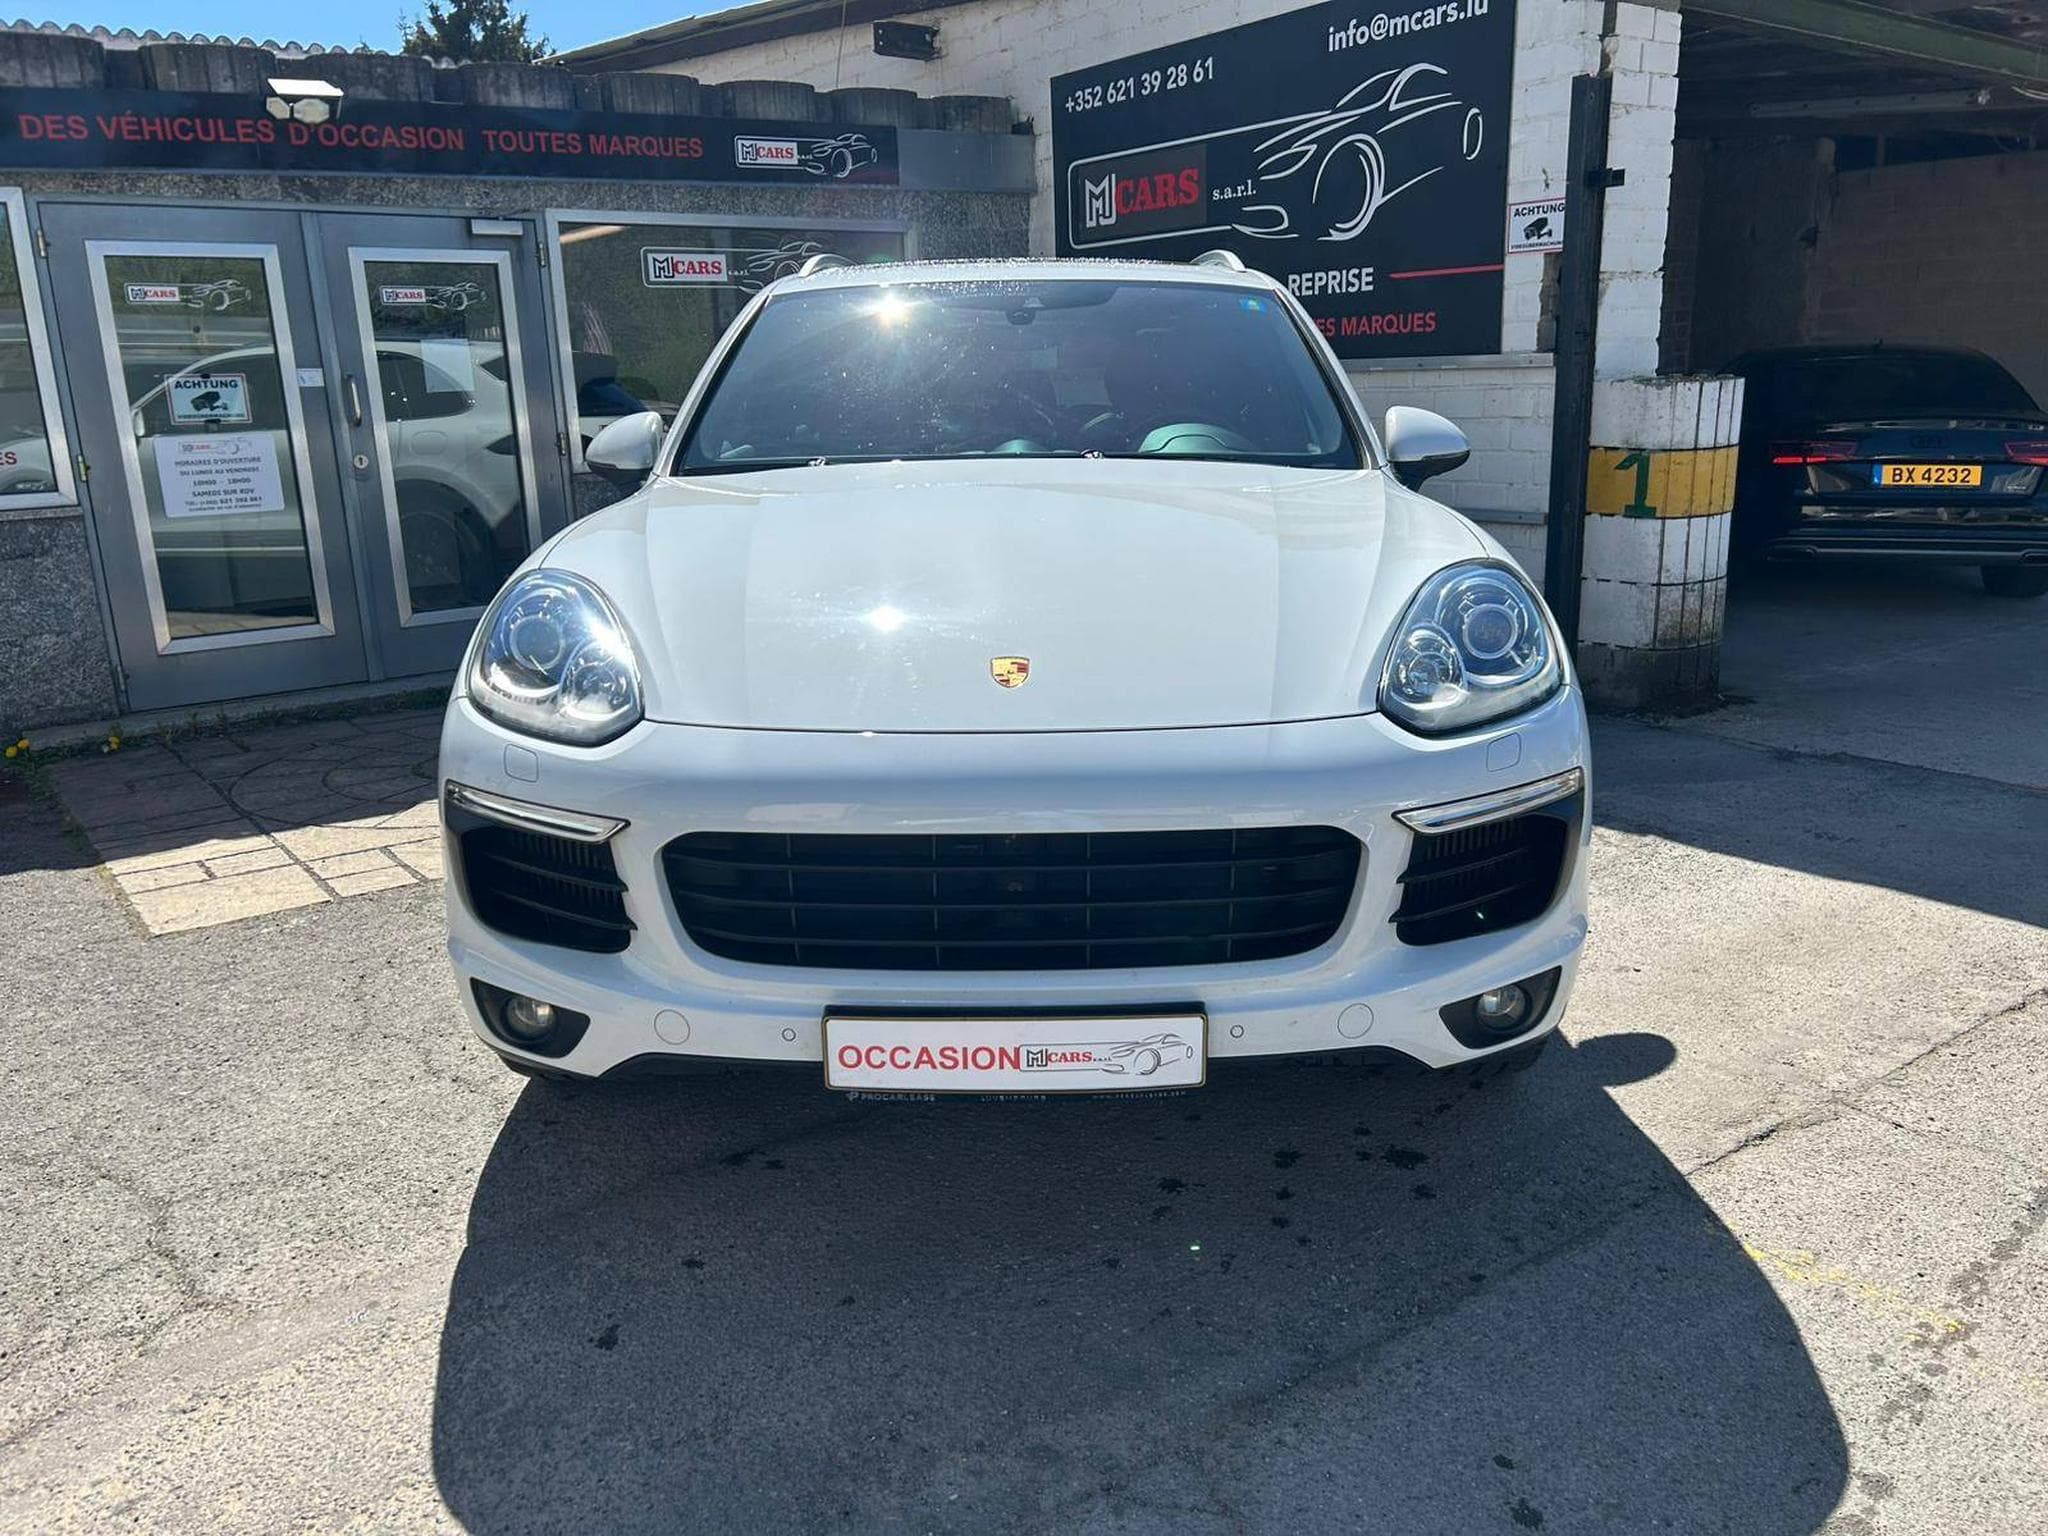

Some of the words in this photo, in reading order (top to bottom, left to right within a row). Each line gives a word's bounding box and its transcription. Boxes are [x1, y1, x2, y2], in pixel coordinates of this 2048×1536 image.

[1329, 0, 1489, 52] info@mcars.lu
[1065, 86, 1103, 113] +352
[1107, 77, 1134, 104] 621
[1141, 71, 1161, 95] 39
[1167, 64, 1187, 90] 28
[1193, 57, 1213, 82] 61
[19, 114, 88, 141] DES
[98, 109, 275, 143] VÉHICULES
[289, 121, 465, 151] D'OCCASION
[482, 130, 583, 154] TOUTES
[588, 135, 704, 158] MARQUES
[1212, 180, 1257, 200] s.a.r.l.
[1513, 203, 1565, 217] ACHTUNG
[1288, 267, 1374, 296] REPRISE
[1341, 312, 1437, 336] MARQUES
[174, 380, 238, 389] ACHTUNG
[1615, 453, 1656, 517] 1
[1892, 467, 1916, 483] BX
[1921, 467, 1971, 483] 4232
[838, 1045, 1020, 1071] OCCASION
